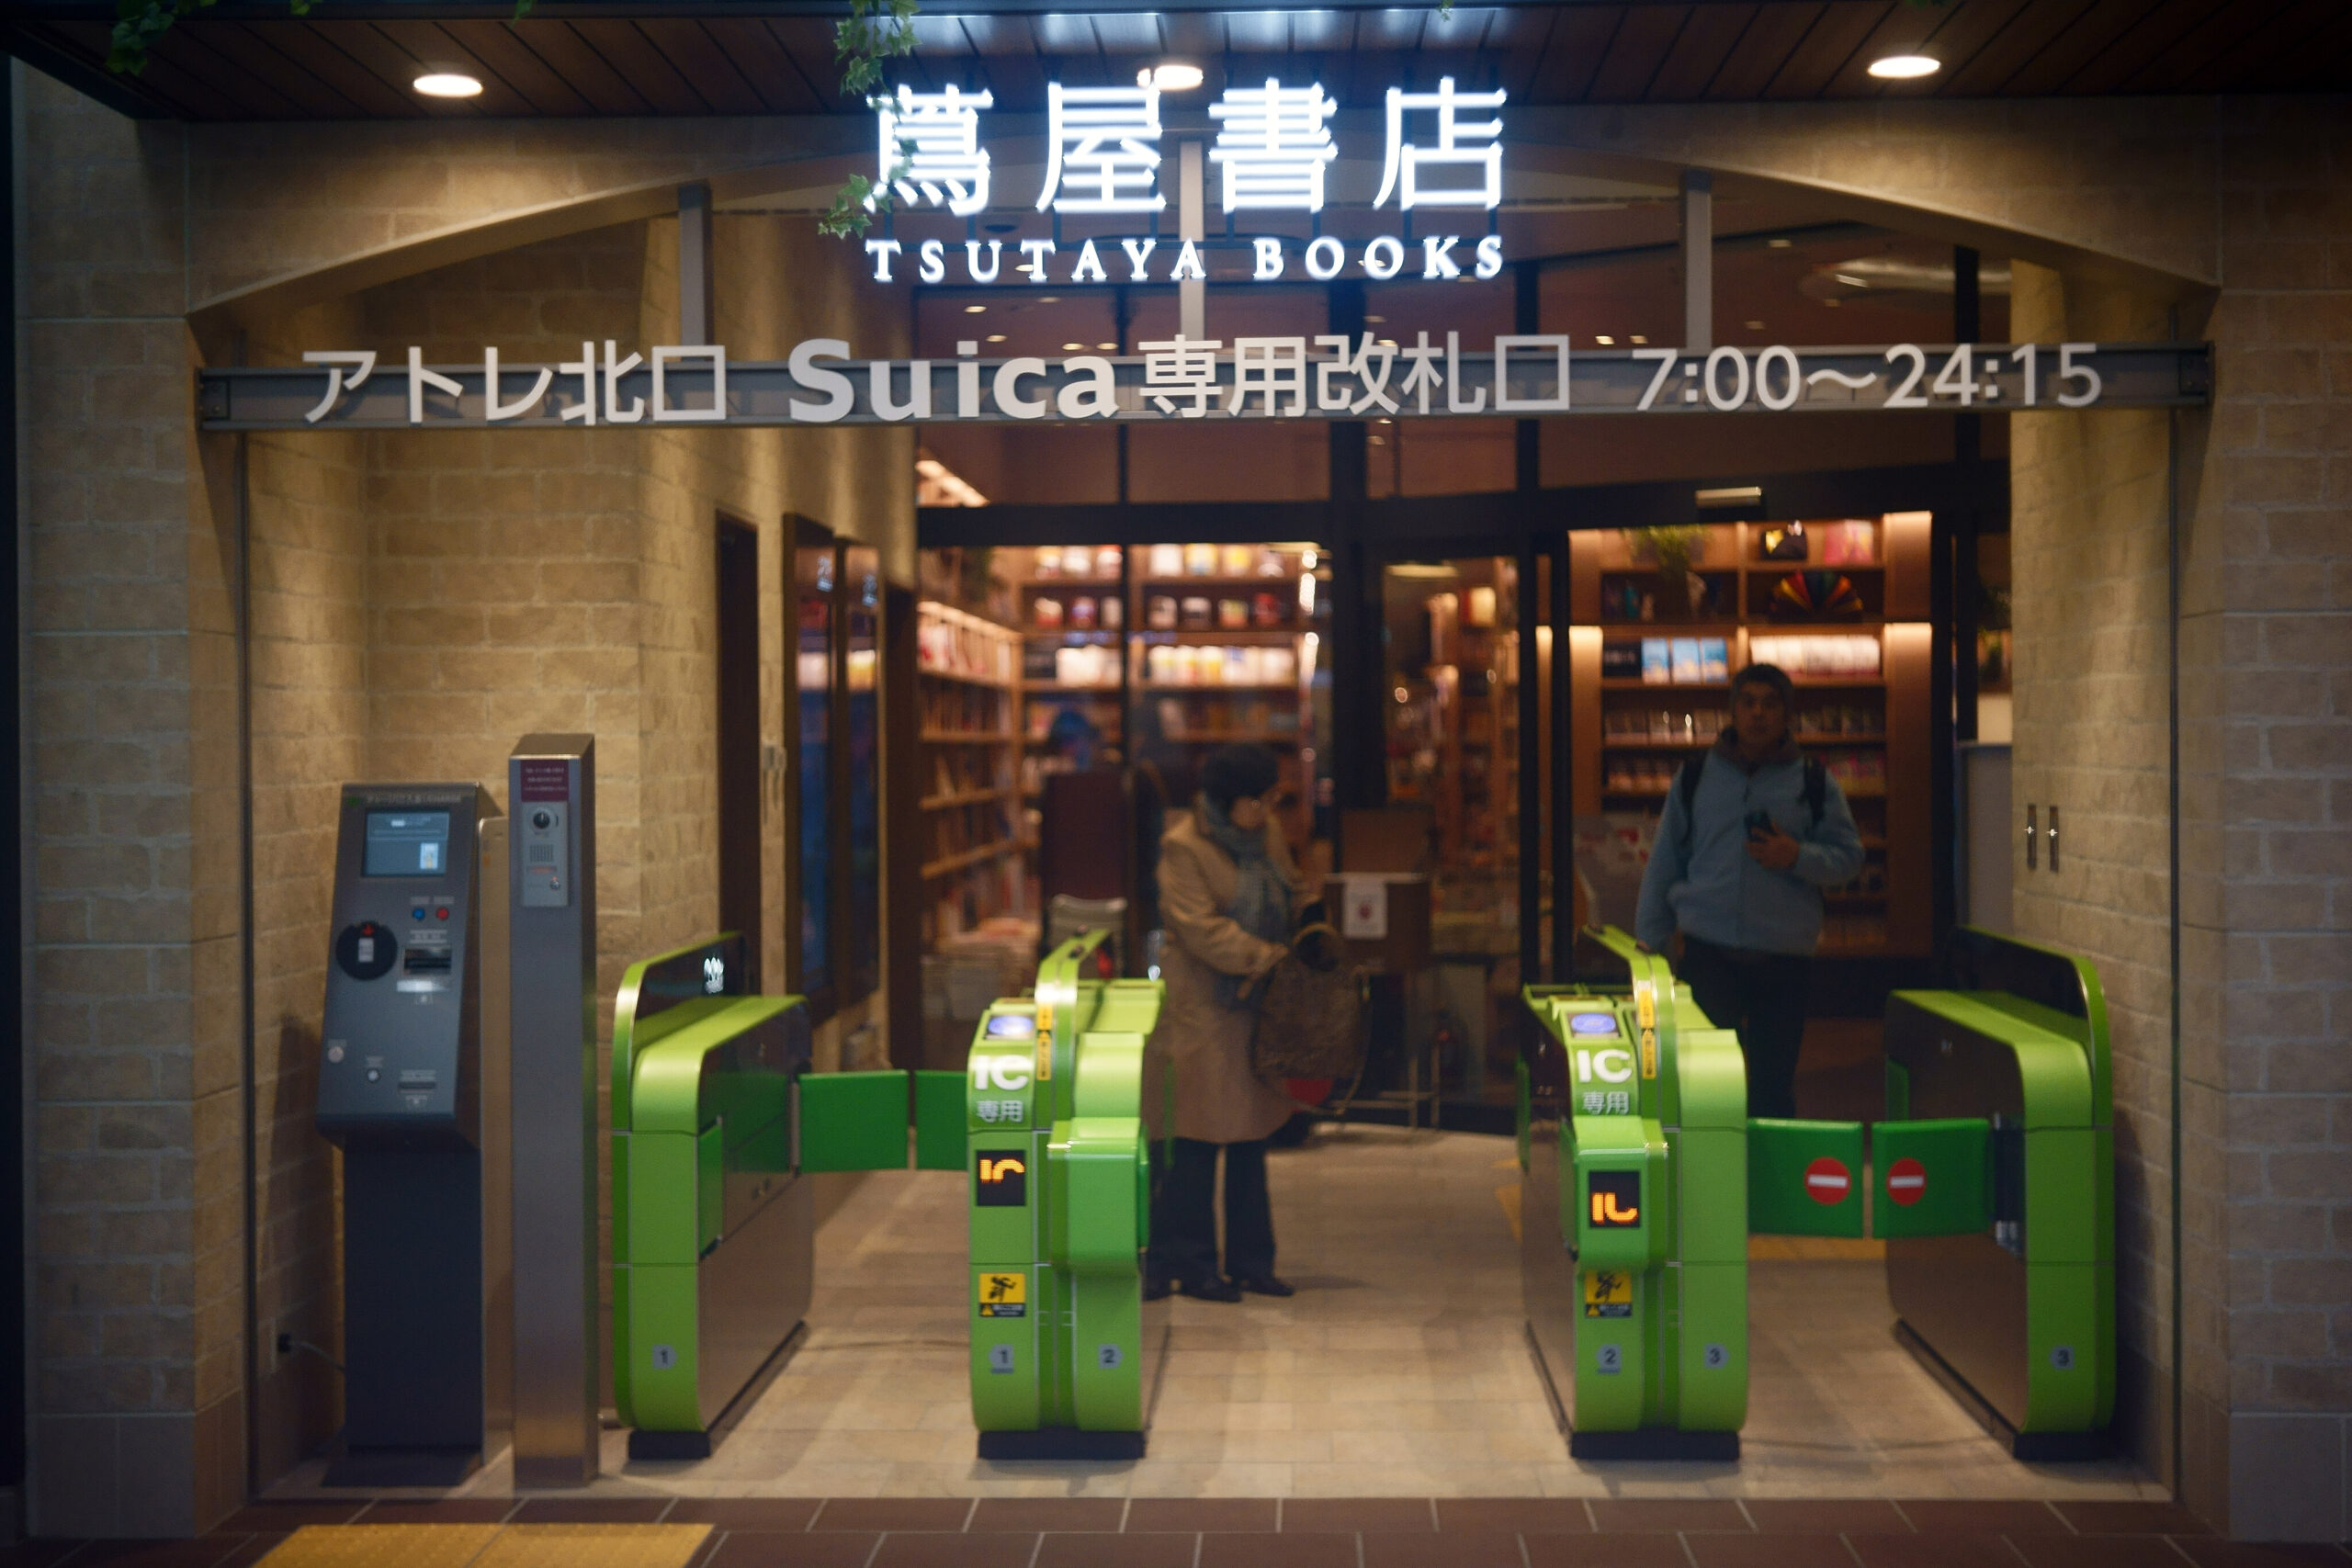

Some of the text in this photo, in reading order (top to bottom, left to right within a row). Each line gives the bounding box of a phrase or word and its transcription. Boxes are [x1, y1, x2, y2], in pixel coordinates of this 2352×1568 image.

[865, 76, 1508, 217] 蔦屋書店
[865, 235, 1504, 282] TSUTAYA BOOKS
[302, 339, 726, 425] アトレ北口
[975, 1055, 1035, 1090] IC
[1577, 1048, 1633, 1083] IC
[977, 1100, 1023, 1122] 専用
[1582, 1091, 1630, 1114] 専用
[1102, 1348, 1115, 1364] 2
[1604, 1348, 1617, 1365] 2
[1709, 1348, 1721, 1365] 3
